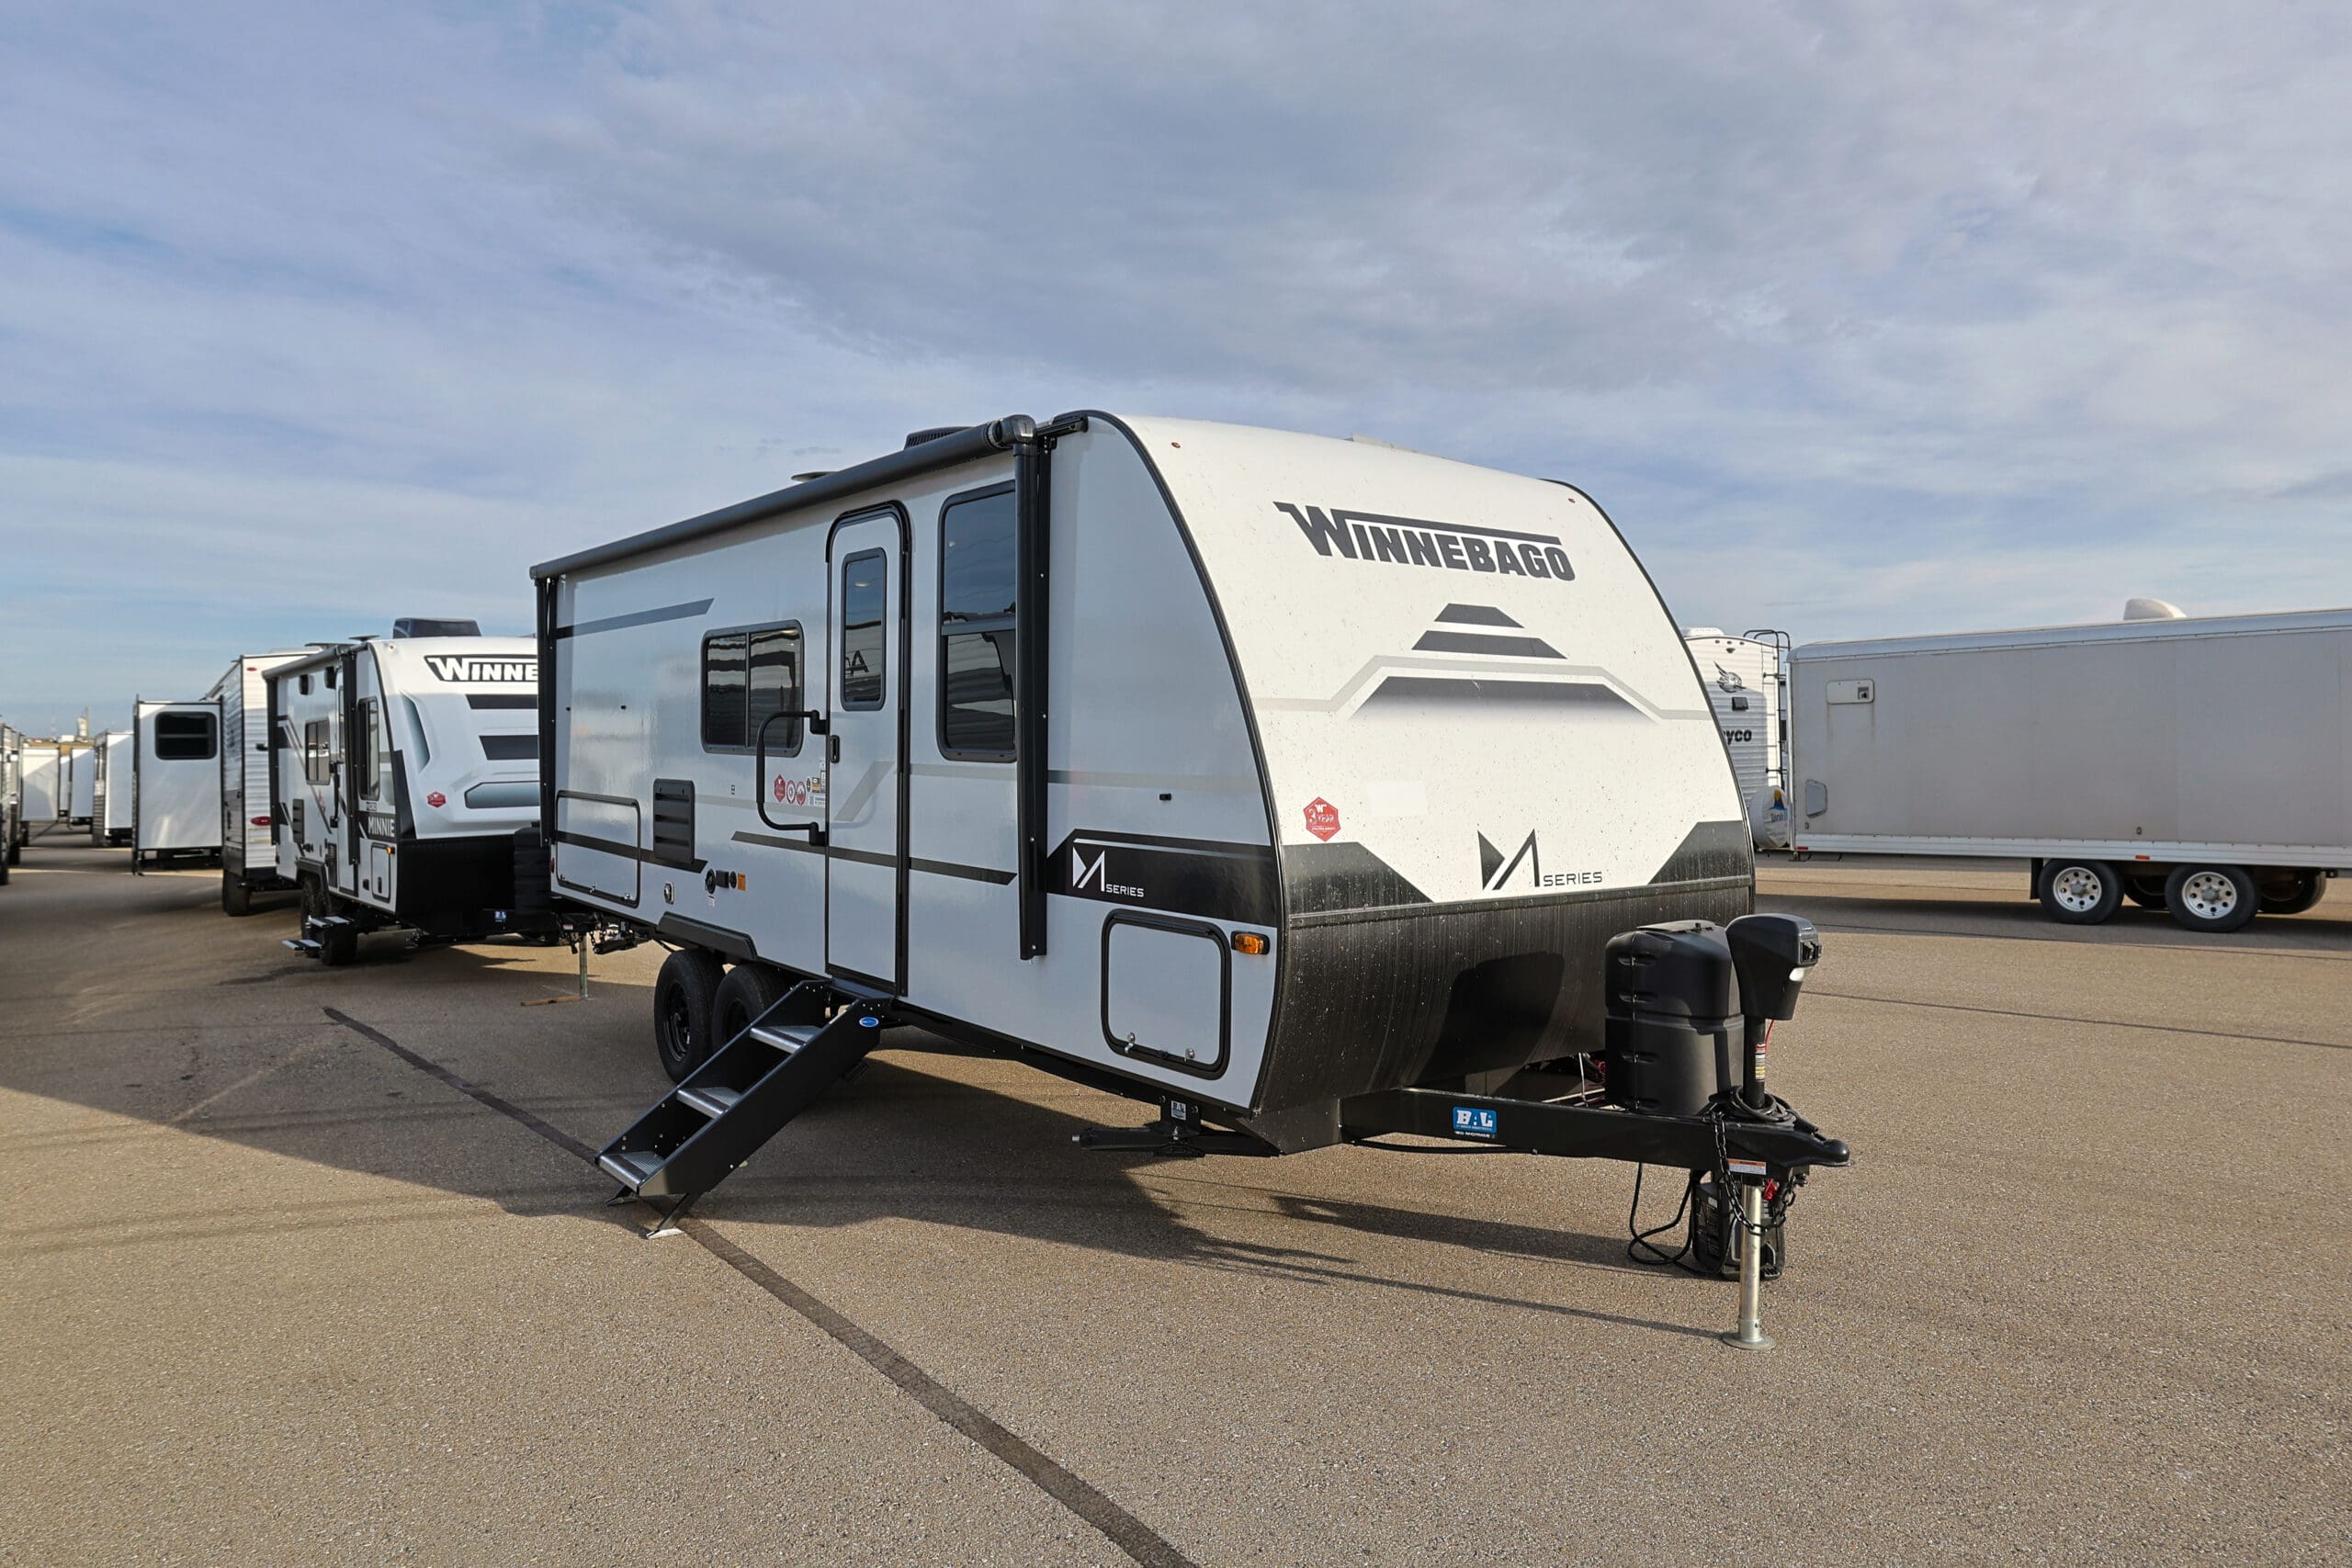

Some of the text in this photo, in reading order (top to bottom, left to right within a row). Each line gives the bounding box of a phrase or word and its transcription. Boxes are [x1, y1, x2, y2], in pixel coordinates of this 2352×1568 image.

[1272, 502, 1576, 581] WINNEBAGO
[424, 655, 538, 682] WINNE
[1724, 729, 1752, 746] yco
[368, 816, 395, 838] MINNIE
[1544, 872, 1603, 886] SERIES
[1106, 884, 1145, 897] SERIES
[1456, 1110, 1493, 1127] BAL
